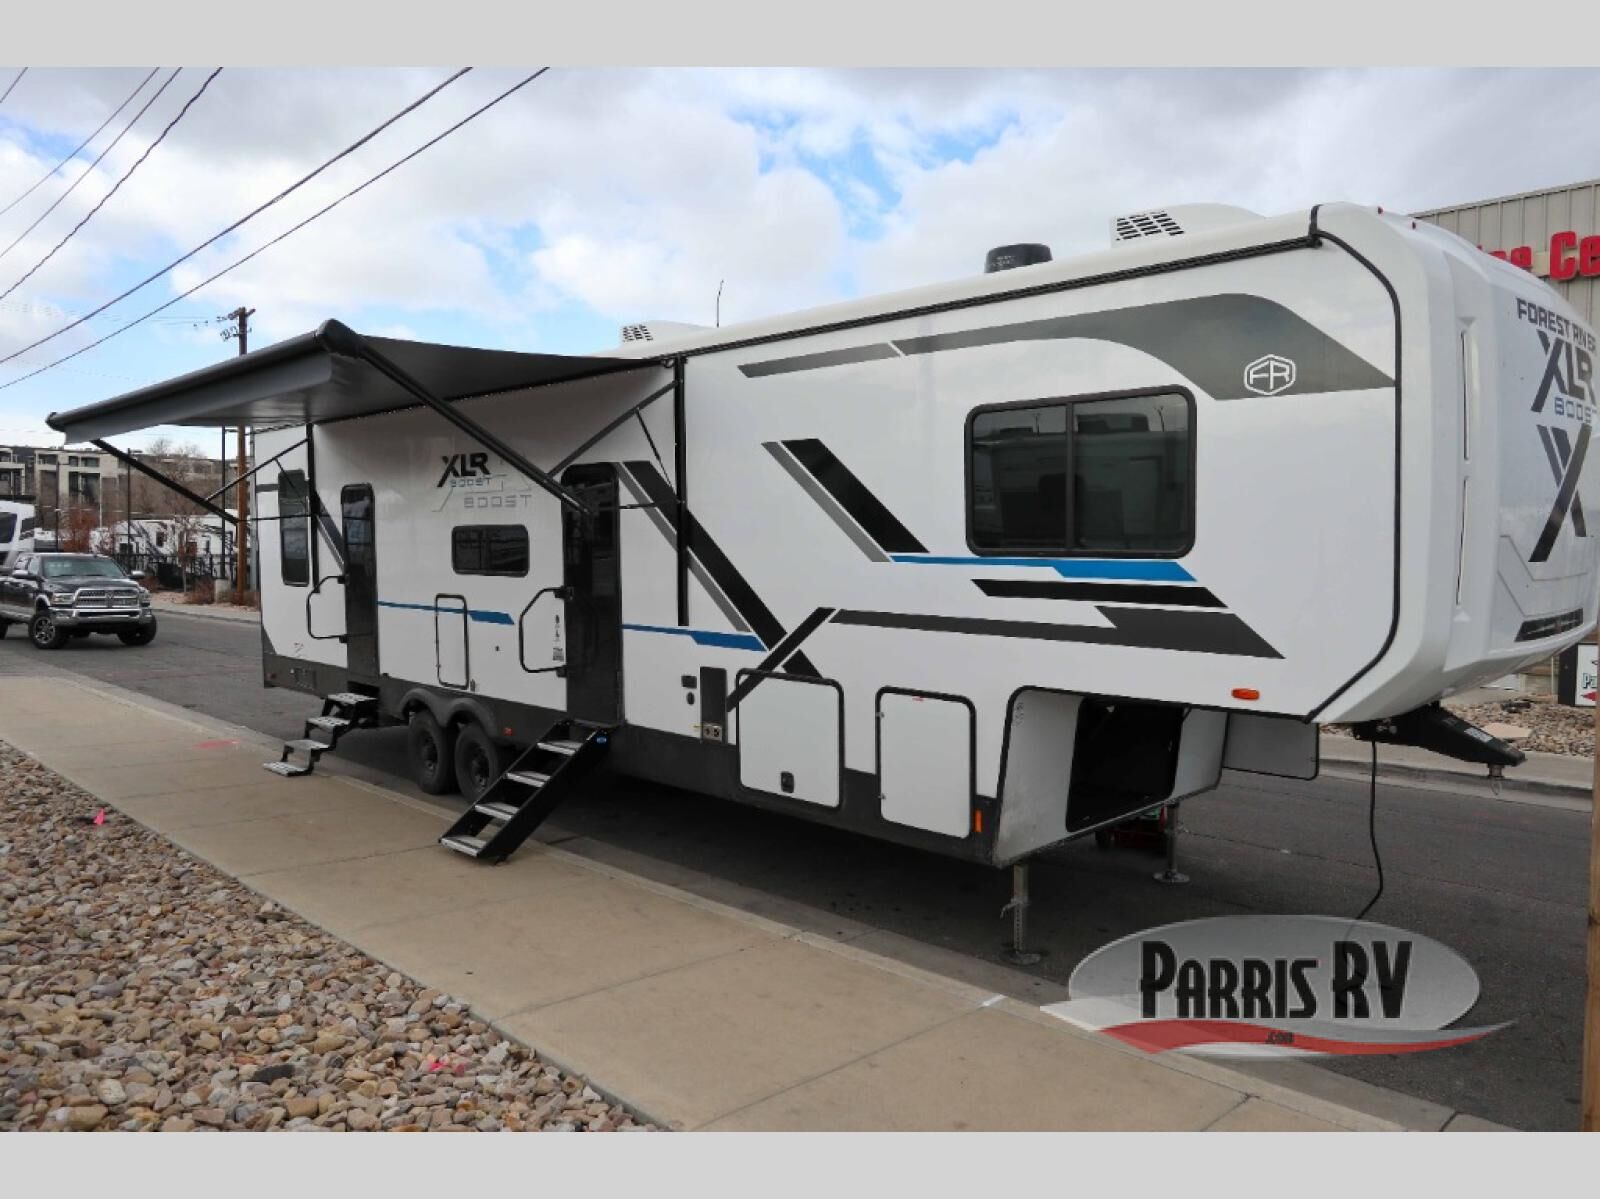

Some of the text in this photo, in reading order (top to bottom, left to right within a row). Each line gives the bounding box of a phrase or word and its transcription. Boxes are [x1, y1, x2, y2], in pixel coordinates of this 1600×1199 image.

[1516, 297, 1570, 338] FOREST
[1530, 329, 1597, 413] XLR
[437, 452, 490, 488] XLR
[463, 494, 532, 508] BOOST
